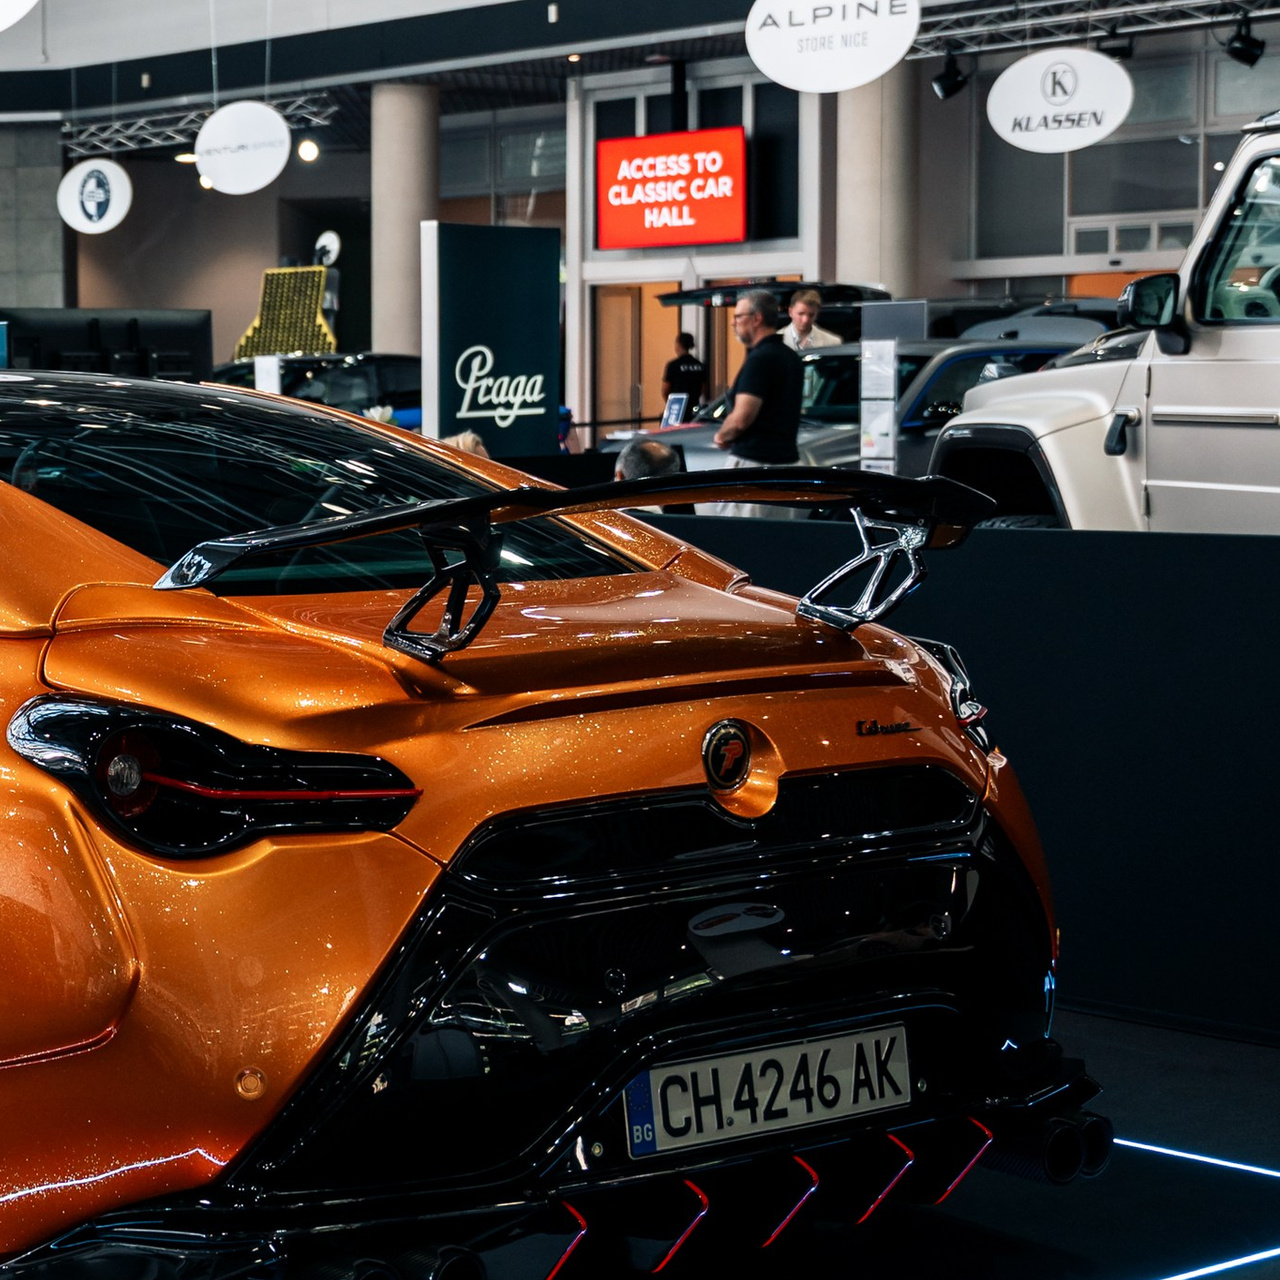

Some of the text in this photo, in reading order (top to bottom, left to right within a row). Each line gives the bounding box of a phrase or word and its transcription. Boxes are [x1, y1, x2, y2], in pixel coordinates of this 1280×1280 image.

[797, 31, 869, 54] STORE NICE
[1011, 110, 1104, 133] KLASSEN
[617, 150, 724, 181] ACCESS TO
[608, 176, 734, 206] CLASSIC CAR
[644, 205, 697, 229] HALL
[455, 345, 547, 428] Praga
[658, 1035, 903, 1138] CH 4246 AK
[632, 1123, 653, 1144] BG
